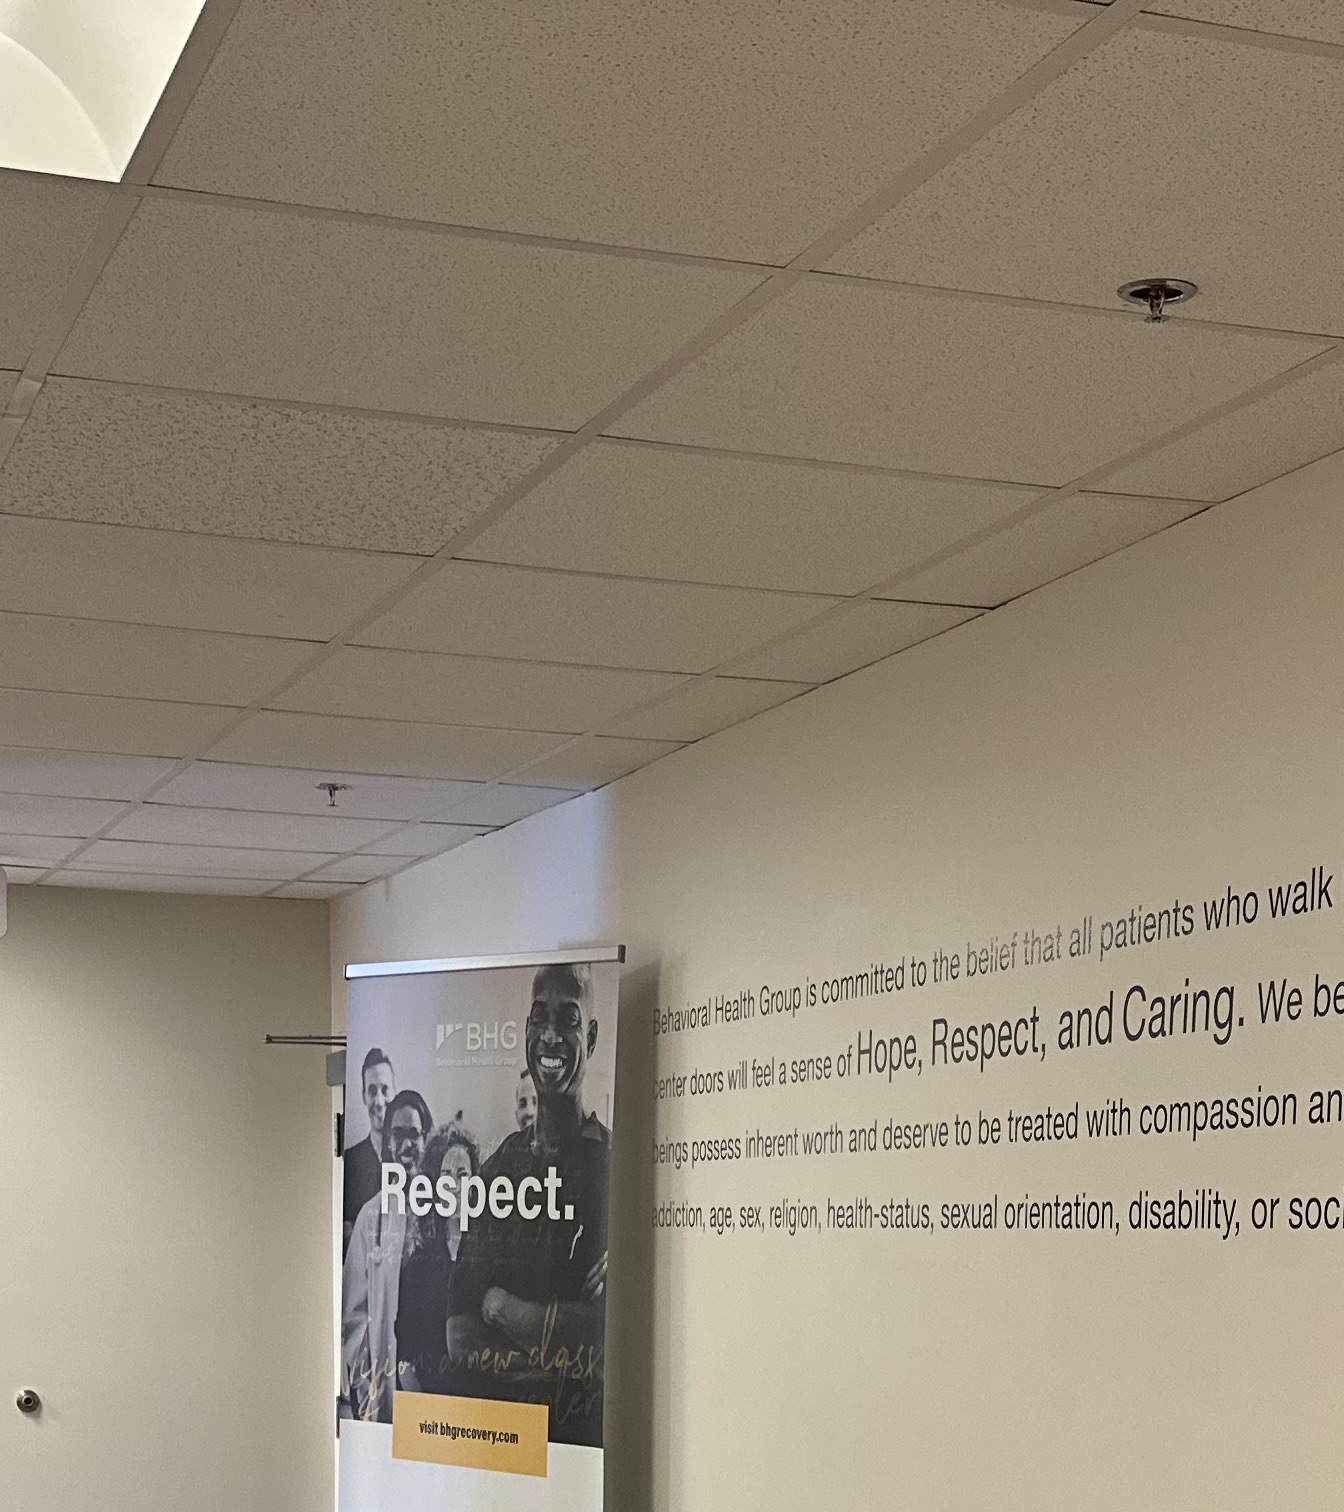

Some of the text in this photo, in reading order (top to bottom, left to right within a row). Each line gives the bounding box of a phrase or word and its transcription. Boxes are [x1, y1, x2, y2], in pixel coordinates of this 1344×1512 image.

[653, 997, 711, 1037] Behavioral
[714, 990, 755, 1023] Health
[759, 983, 801, 1018] Group
[806, 978, 817, 1007] is
[822, 957, 904, 1004] committed
[911, 957, 927, 987] to
[933, 949, 960, 983] the
[966, 932, 1018, 977] belief
[1024, 930, 1062, 966] that
[1069, 917, 1092, 957] all
[1100, 901, 1194, 962] patients
[1203, 887, 1258, 931] who
[1268, 867, 1334, 919] walk
[467, 1020, 517, 1051] BHG
[690, 1060, 724, 1095] doors
[728, 1057, 747, 1090] will
[752, 1055, 775, 1088] feel
[779, 1061, 786, 1084] a
[790, 1054, 832, 1083] sense
[837, 1046, 853, 1077] of
[857, 1031, 923, 1082] Hope,
[931, 1006, 1046, 1072] Respect,
[1058, 991, 1114, 1050] and
[1122, 979, 1245, 1045] Caring.
[1258, 980, 1303, 1024] We
[691, 1138, 741, 1168] possess
[745, 1129, 798, 1159] inherent
[803, 1123, 843, 1155] worth
[849, 1120, 877, 1153] and
[883, 1117, 949, 1150] deserve
[954, 1116, 971, 1146] to
[978, 1111, 1001, 1144] be
[1008, 1103, 1079, 1143] treated
[1086, 1100, 1131, 1138] with
[1139, 1084, 1298, 1141] compassion
[381, 1162, 575, 1232] Respect.
[652, 1199, 706, 1234] addiction,
[710, 1205, 735, 1234] age,
[739, 1205, 765, 1230] sex,
[769, 1199, 822, 1235] religion,
[827, 1198, 934, 1233] health-status,
[940, 1195, 998, 1230] sexual
[1004, 1193, 1120, 1234] orientation,
[1129, 1188, 1241, 1240] disability,
[1251, 1197, 1280, 1230] or
[420, 1420, 519, 1445] visit bhgrecovery.com
